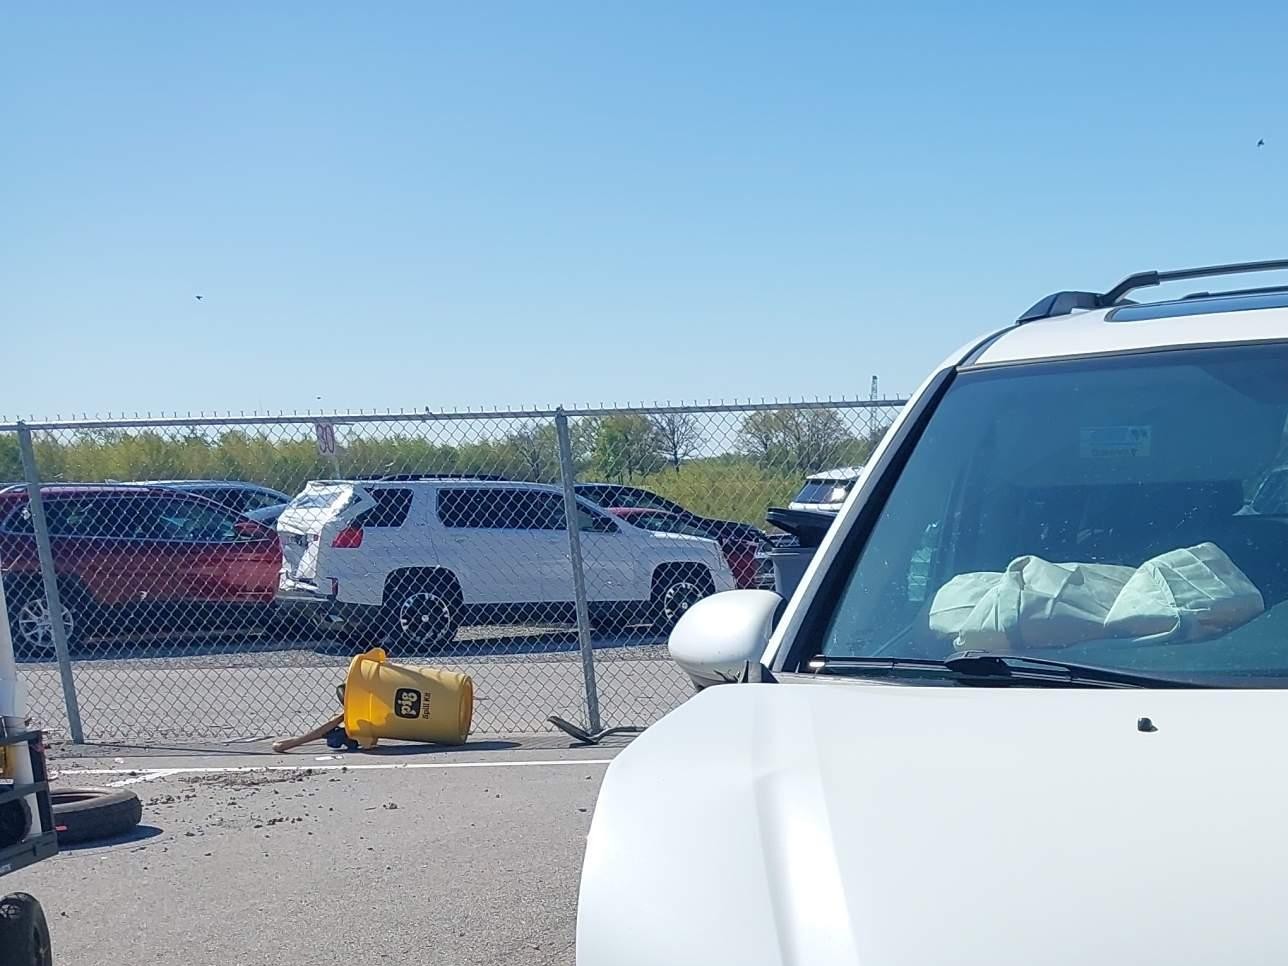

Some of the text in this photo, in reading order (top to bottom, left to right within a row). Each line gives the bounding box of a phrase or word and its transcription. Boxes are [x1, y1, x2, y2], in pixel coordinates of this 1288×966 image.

[397, 691, 418, 716] pig
[422, 692, 431, 719] Spill Kit
